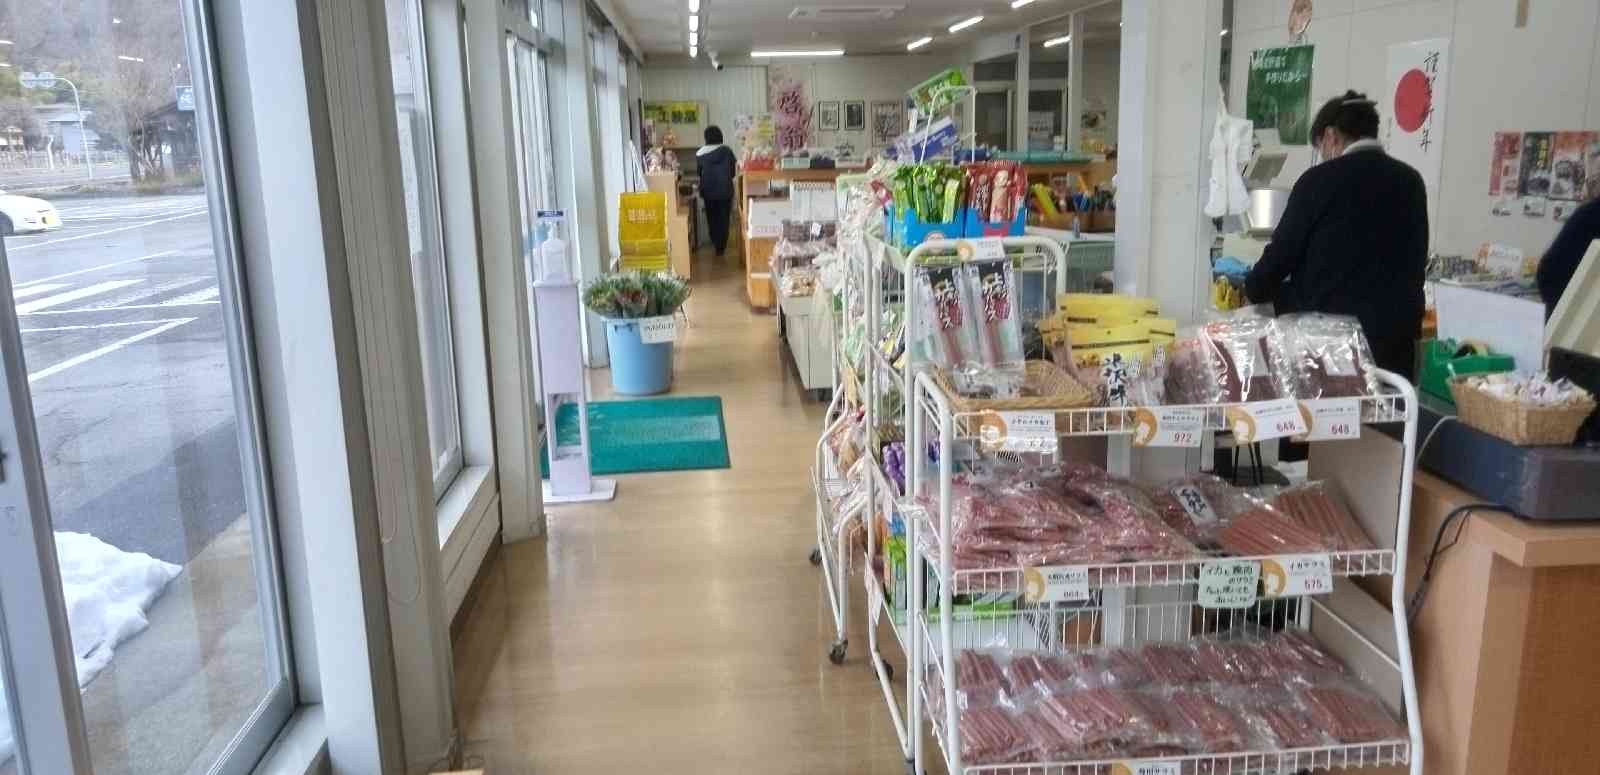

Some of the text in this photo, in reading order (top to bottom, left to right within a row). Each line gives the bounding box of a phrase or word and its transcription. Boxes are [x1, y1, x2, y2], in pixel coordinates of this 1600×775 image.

[1420, 49, 1440, 153] 謹賀新年
[1330, 423, 1350, 435] 648
[1174, 432, 1193, 442] 972
